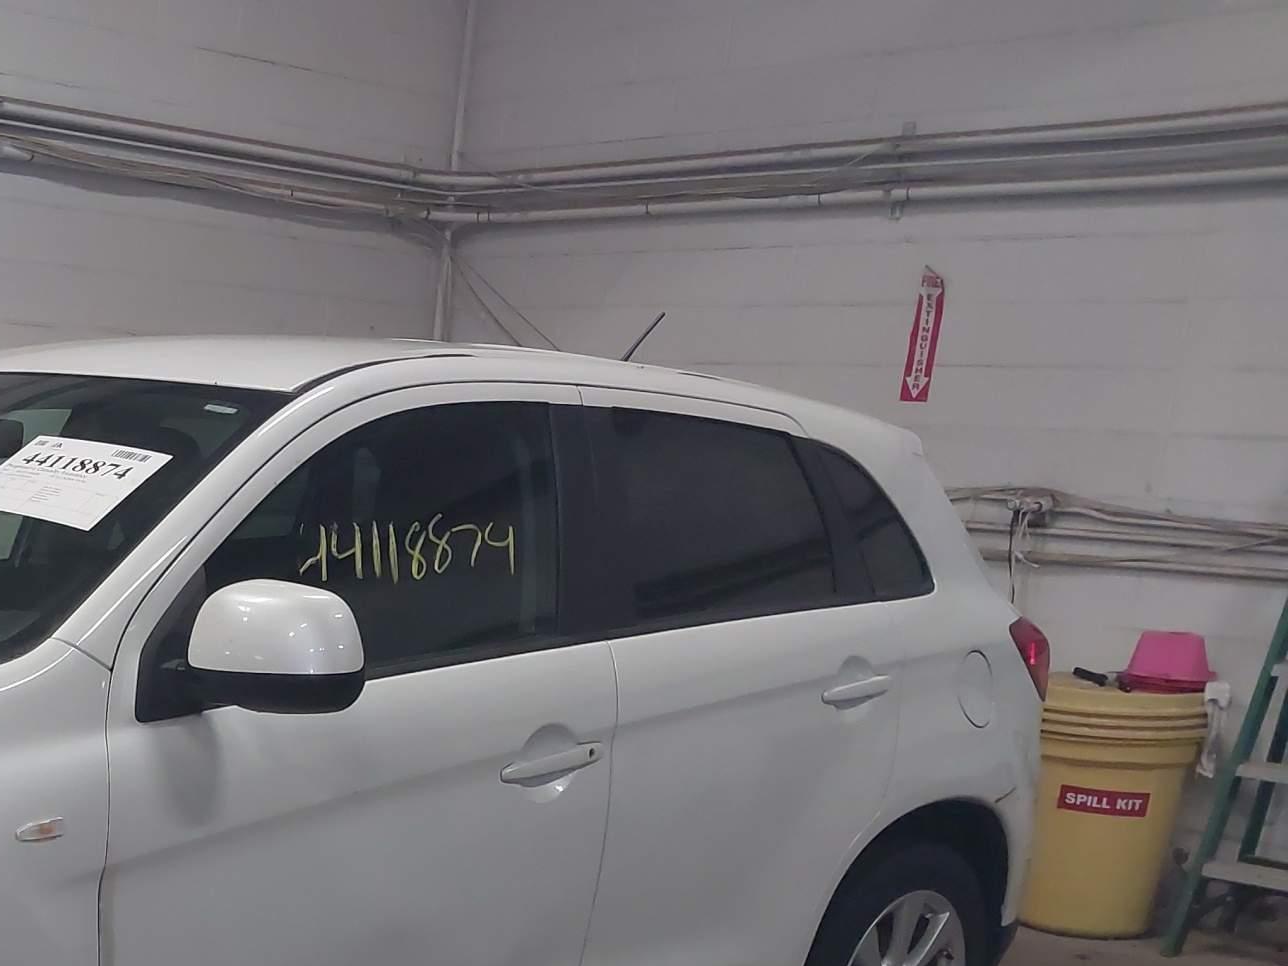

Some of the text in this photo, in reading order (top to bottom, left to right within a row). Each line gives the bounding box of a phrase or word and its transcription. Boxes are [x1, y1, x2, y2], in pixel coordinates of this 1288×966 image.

[911, 293, 934, 391] EXTINGUISHER
[22, 452, 134, 480] 44118874
[1064, 792, 1144, 811] SPILL KIT
